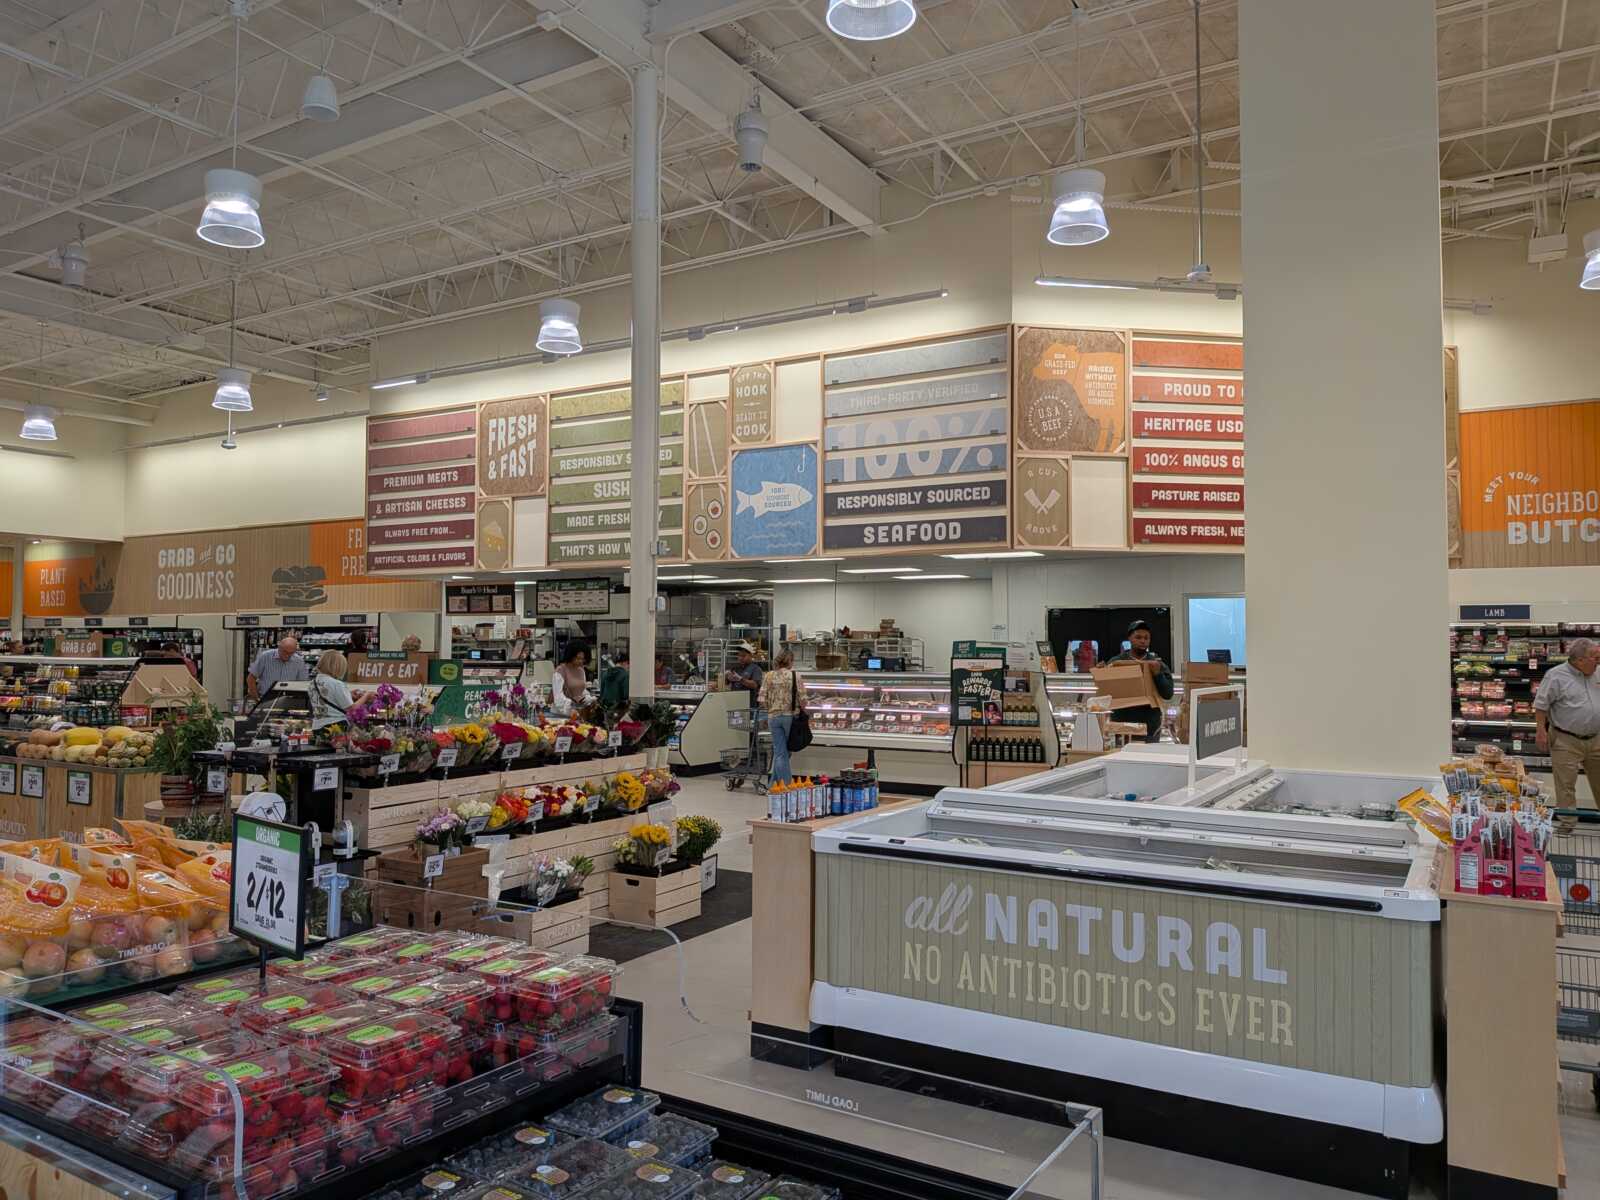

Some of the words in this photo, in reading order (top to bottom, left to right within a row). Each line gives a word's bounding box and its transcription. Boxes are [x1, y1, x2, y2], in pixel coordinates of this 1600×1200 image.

[736, 384, 768, 398] HOOK
[850, 388, 923, 409] THIRD-PARTY
[927, 383, 979, 400] VERIFIED
[1164, 383, 1212, 397] PROUD
[1217, 384, 1235, 398] TO
[736, 424, 767, 437] COOK
[1042, 418, 1062, 432] BEEF
[1144, 417, 1212, 432] HERITAGE
[1217, 420, 1244, 434] USD
[488, 414, 537, 456] FRESH
[838, 408, 992, 482] 100%
[488, 459, 497, 480] &
[500, 439, 537, 479] FAST
[560, 454, 624, 471] RESPONSIBLY
[1144, 452, 1179, 466] 100%
[1184, 454, 1228, 468] ANGUS
[384, 474, 424, 488] PREMIUM
[427, 470, 458, 484] MEATS
[1484, 475, 1504, 503] MEET
[1508, 472, 1540, 485] YOUR
[594, 480, 631, 498] SUSH
[837, 491, 922, 509] RESPONSIBLY
[928, 486, 991, 504] SOURCED
[1152, 490, 1200, 501] PASTURE
[1203, 491, 1240, 502] RAISED
[376, 504, 382, 514] &
[385, 500, 422, 514] ARTISAN
[426, 497, 466, 510] CHEESES
[1506, 490, 1599, 516] NEIGHBO
[566, 514, 595, 528] MADE
[385, 528, 410, 538] ALWAYS
[412, 528, 428, 536] FREE
[863, 522, 961, 544] SEAFOOD
[1144, 525, 1188, 536] ALWAYS
[1507, 518, 1600, 545] BUTC
[158, 547, 195, 568] GRAB
[215, 544, 236, 565] GO
[560, 543, 595, 557] THAT'S
[598, 542, 620, 555] HOW
[375, 556, 405, 565] ARTIFICIAL
[407, 554, 430, 563] COLORS
[439, 552, 466, 560] FLAVORS
[40, 567, 66, 584] PLANT
[157, 570, 234, 600] GOODNESS
[40, 590, 65, 607] BASED
[1484, 608, 1505, 617] LAMB
[61, 642, 78, 654] GRAB
[86, 642, 96, 653] GO
[357, 662, 384, 677] HEAT
[398, 663, 419, 677] EAT
[963, 685, 992, 696] FASTER
[256, 826, 280, 847] ORGANIC
[905, 880, 973, 936] all
[985, 892, 1288, 984] NATURAL
[903, 941, 942, 984] NO
[957, 951, 1177, 1026] ANTIBIOTICS
[1196, 988, 1294, 1046] EVER
